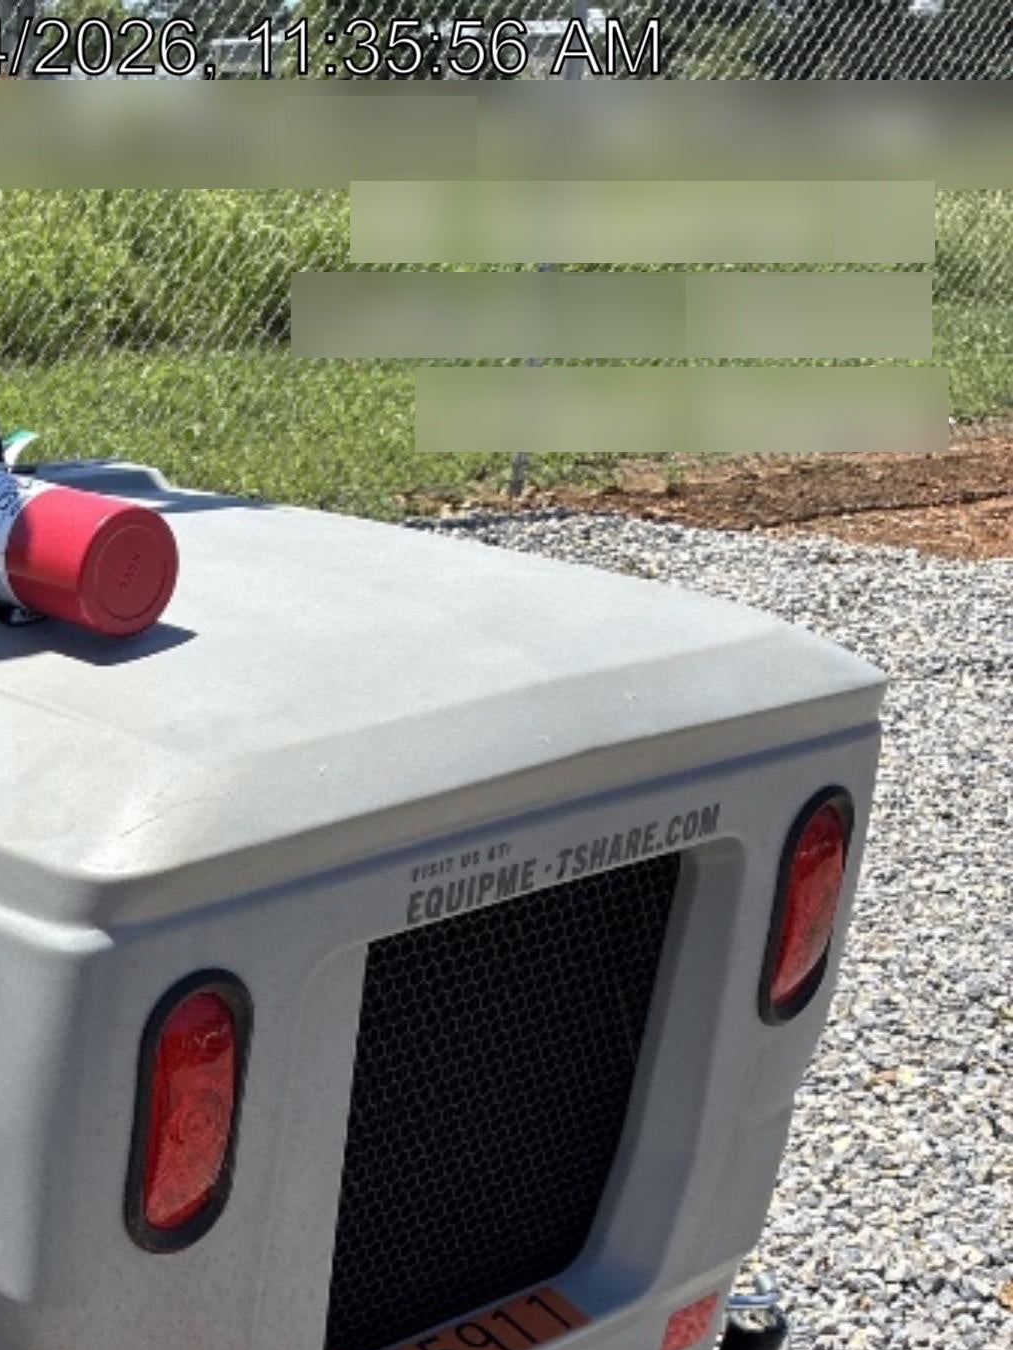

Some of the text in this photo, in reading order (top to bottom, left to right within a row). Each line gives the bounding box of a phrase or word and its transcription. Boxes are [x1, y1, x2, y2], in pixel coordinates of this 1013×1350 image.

[406, 802, 721, 926] EQUIPMETSHARE.COM
[412, 857, 454, 882] VISIT
[461, 851, 480, 868] US
